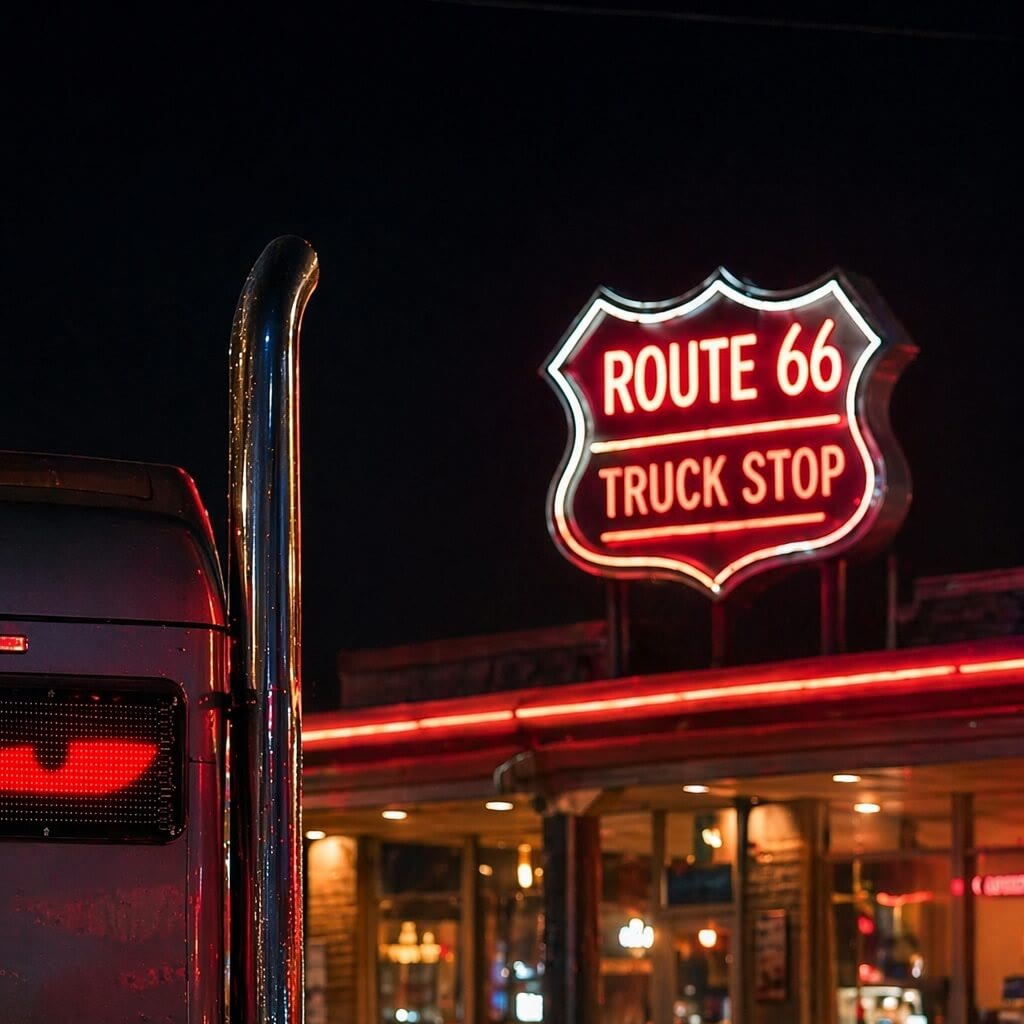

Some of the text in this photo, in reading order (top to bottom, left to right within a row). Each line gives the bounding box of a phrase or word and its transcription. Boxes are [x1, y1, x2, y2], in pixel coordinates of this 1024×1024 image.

[603, 318, 843, 416] ROUTE 66
[598, 445, 846, 518] TRUCK STOP
